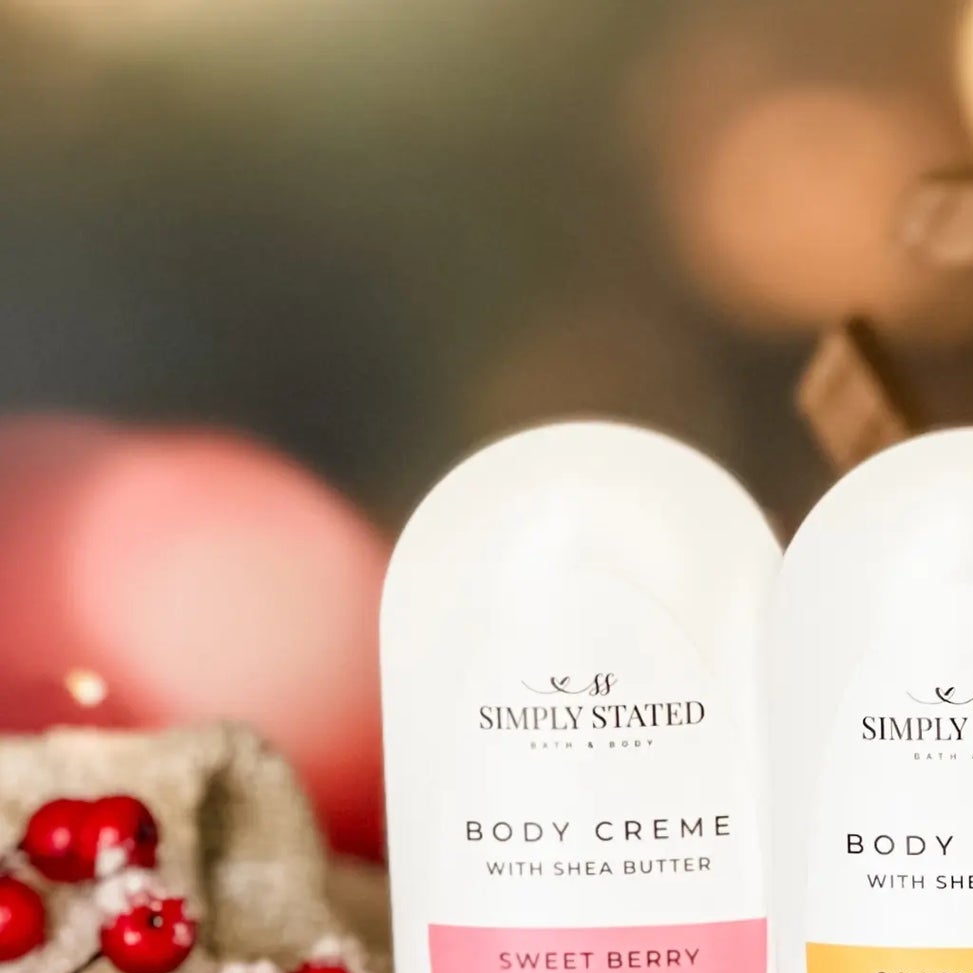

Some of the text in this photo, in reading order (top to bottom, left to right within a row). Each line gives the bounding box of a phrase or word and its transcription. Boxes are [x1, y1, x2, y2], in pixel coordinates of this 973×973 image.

[479, 700, 705, 730] SIMPLY STATED
[862, 716, 967, 740] SIMPLY
[531, 741, 572, 749] BATH
[609, 740, 653, 748] BODY
[914, 752, 957, 760] BATH
[466, 815, 730, 842] BODY CREME
[847, 833, 953, 855] BODY
[486, 857, 711, 876] WITH SHEA BUTTER
[867, 874, 925, 889] WITH
[500, 948, 700, 970] SWEET BERRY
